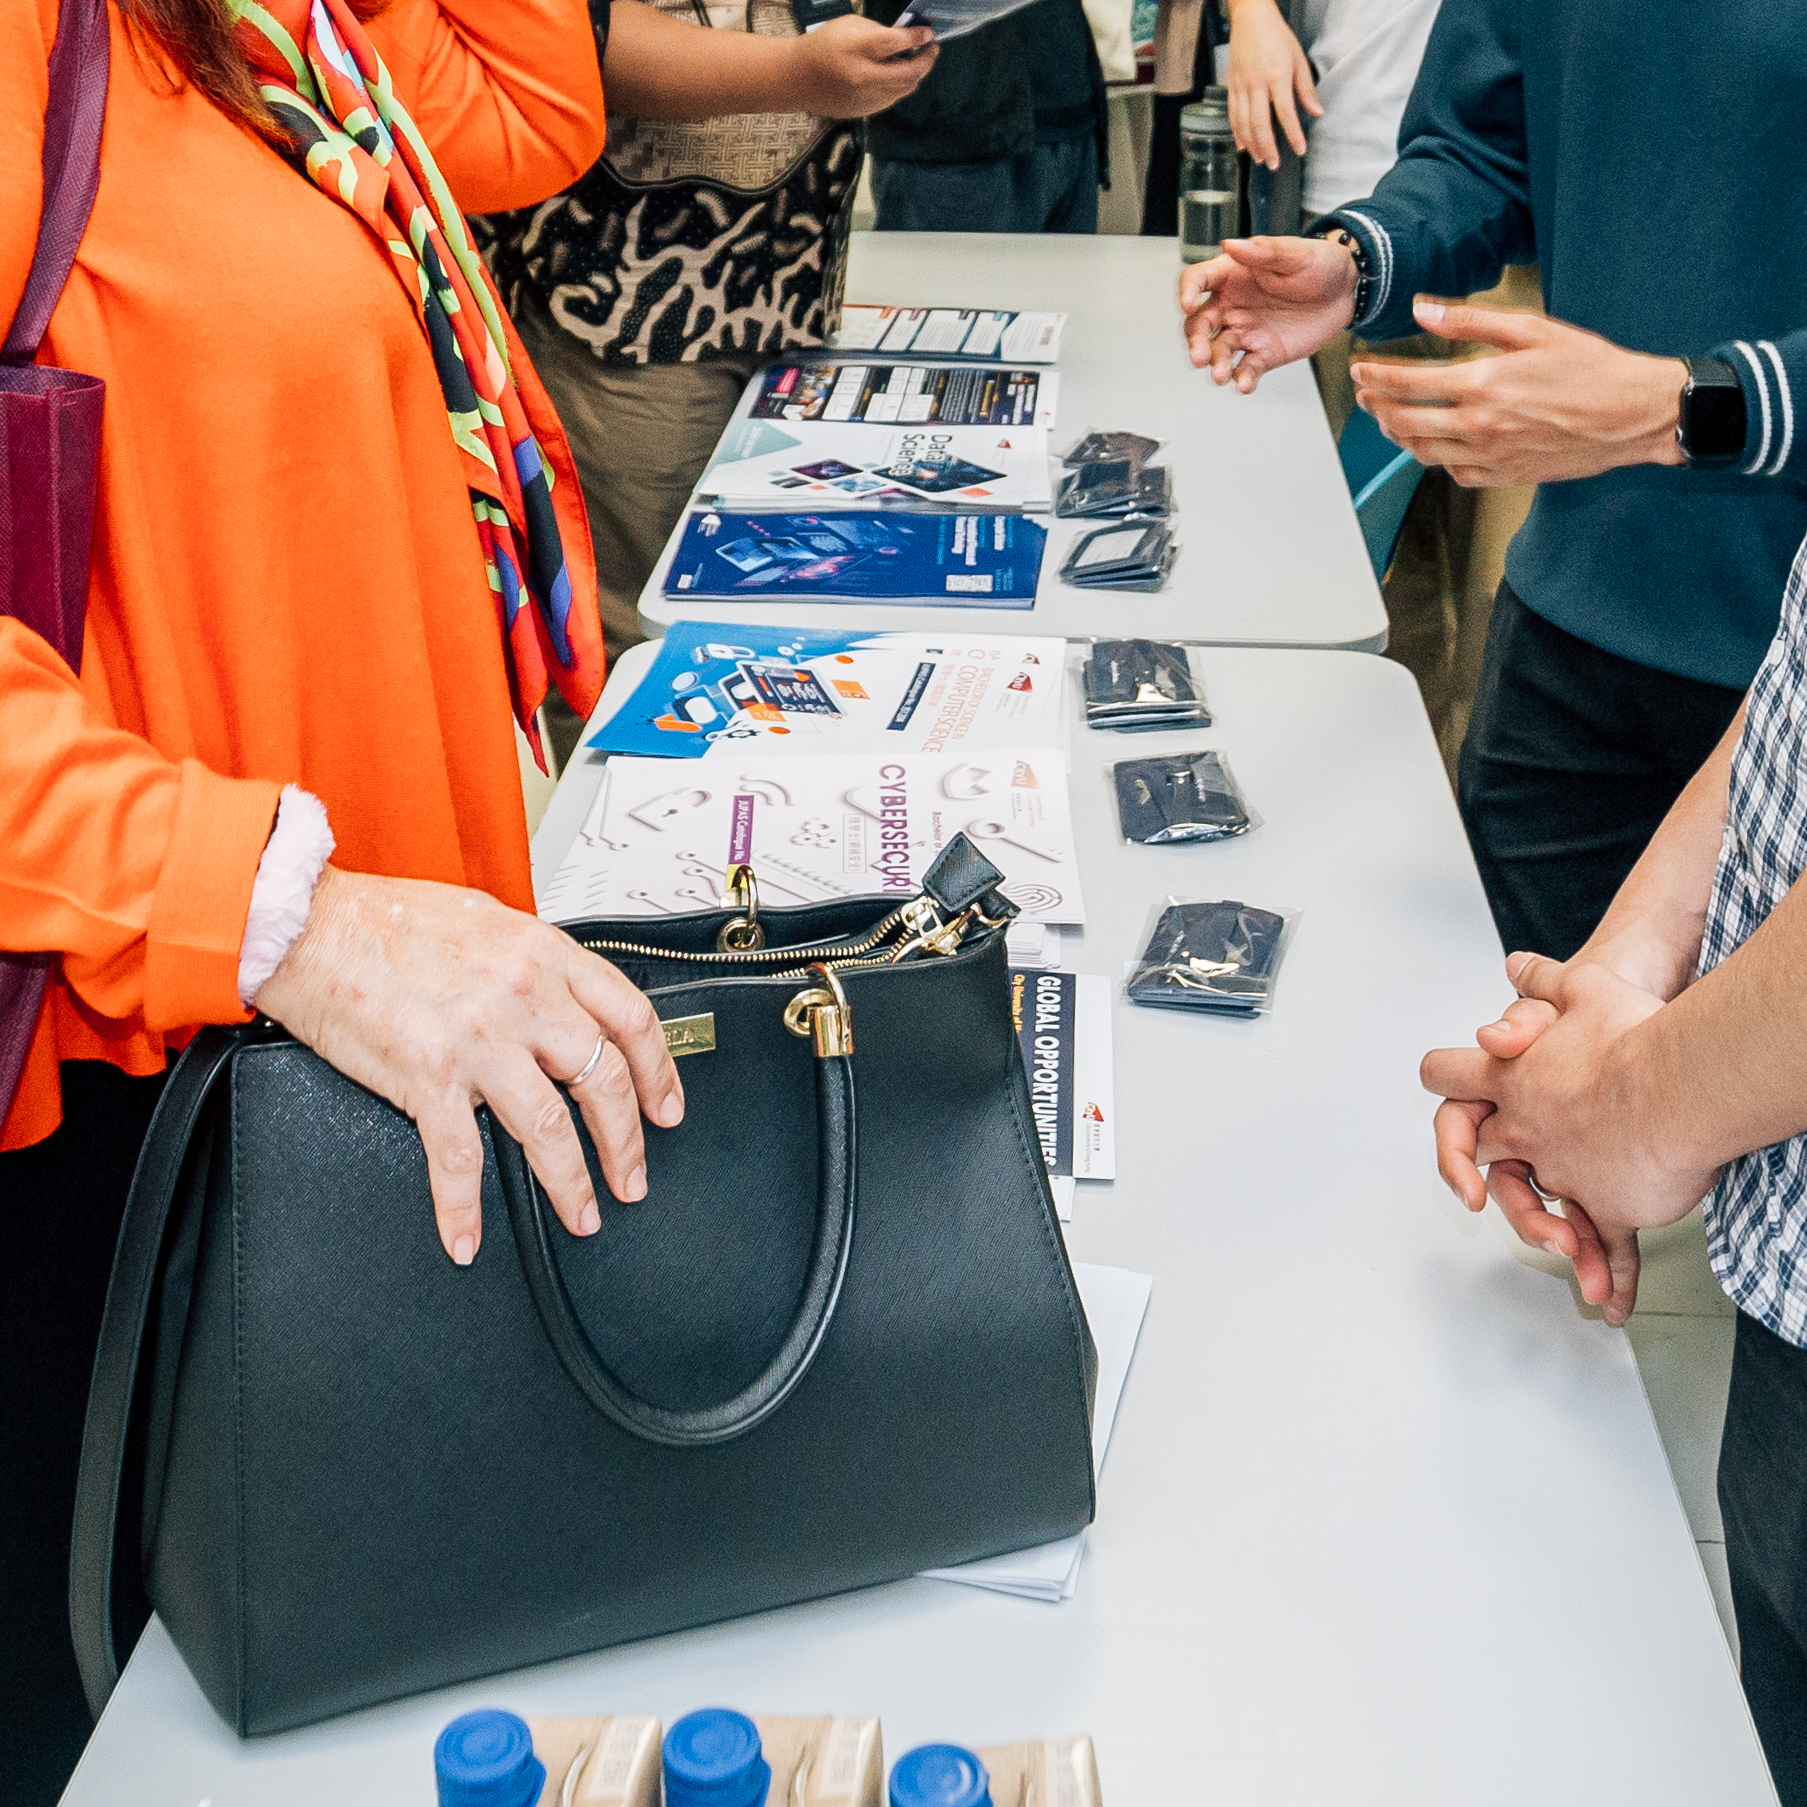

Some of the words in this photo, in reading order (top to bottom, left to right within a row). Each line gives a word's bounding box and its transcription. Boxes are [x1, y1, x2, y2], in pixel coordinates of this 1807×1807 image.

[889, 432, 925, 477] Science
[925, 434, 953, 462] Data
[941, 665, 978, 718] COMPUTER
[921, 718, 957, 752] SCIENCE
[736, 800, 751, 820] JUPAS
[732, 821, 750, 849] Catalogue
[931, 812, 943, 840] Bachelor
[1034, 976, 1062, 1032] GLOBAL
